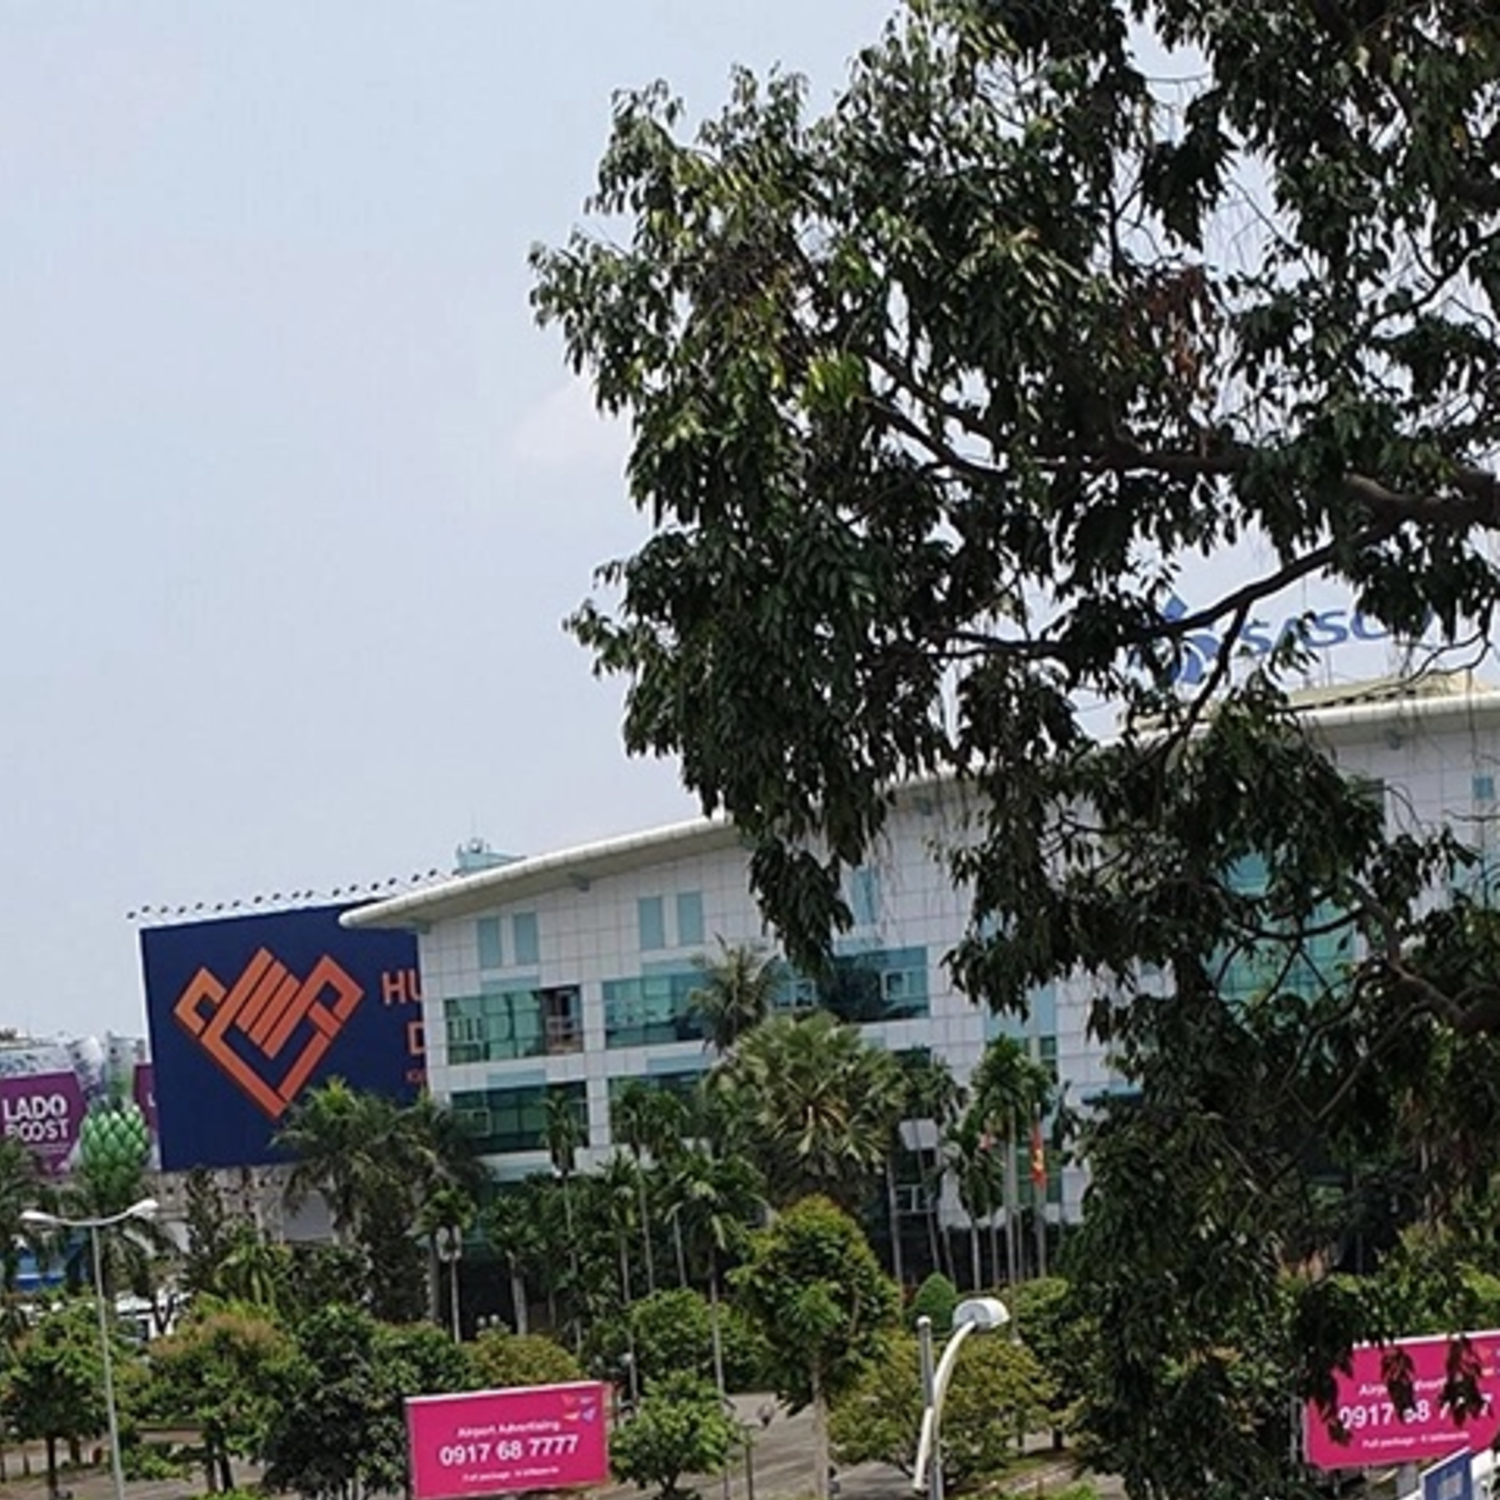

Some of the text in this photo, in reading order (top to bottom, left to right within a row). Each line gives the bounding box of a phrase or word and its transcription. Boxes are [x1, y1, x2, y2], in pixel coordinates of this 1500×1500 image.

[3, 1093, 68, 1121] LADO
[457, 1420, 560, 1438] Airport Advertising
[439, 1434, 579, 1467] 0917 68 7777
